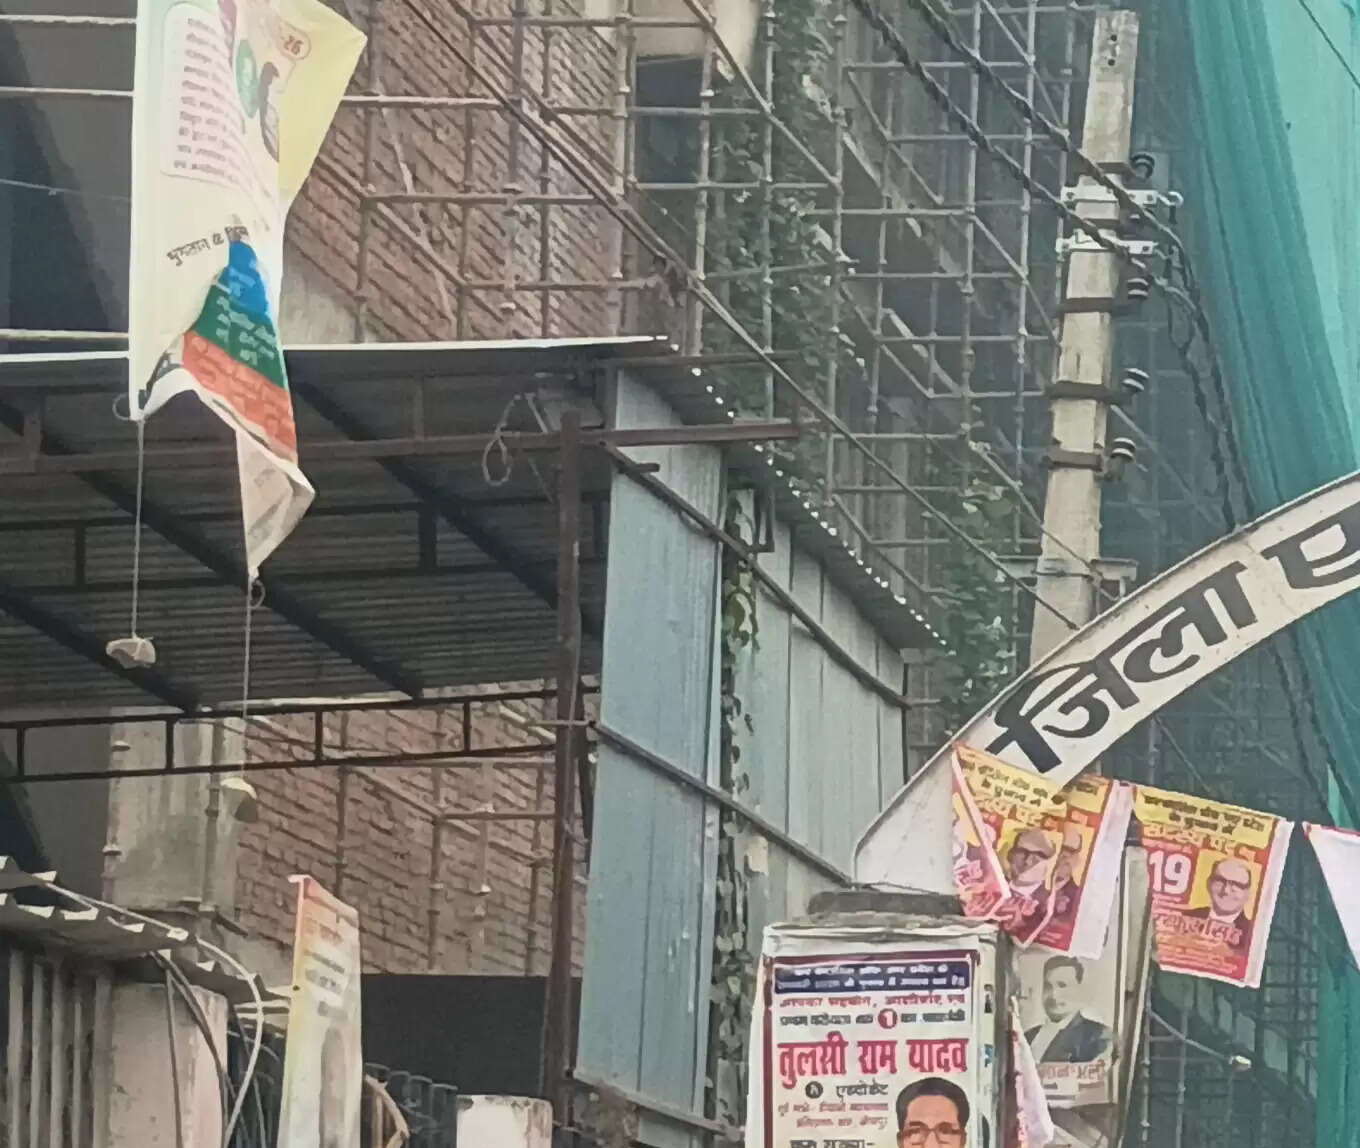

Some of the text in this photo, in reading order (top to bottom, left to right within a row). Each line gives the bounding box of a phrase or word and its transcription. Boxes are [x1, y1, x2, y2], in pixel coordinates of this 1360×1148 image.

[986, 561, 1261, 775] जिला
[776, 1030, 970, 1090] तुलसी राम यादव
